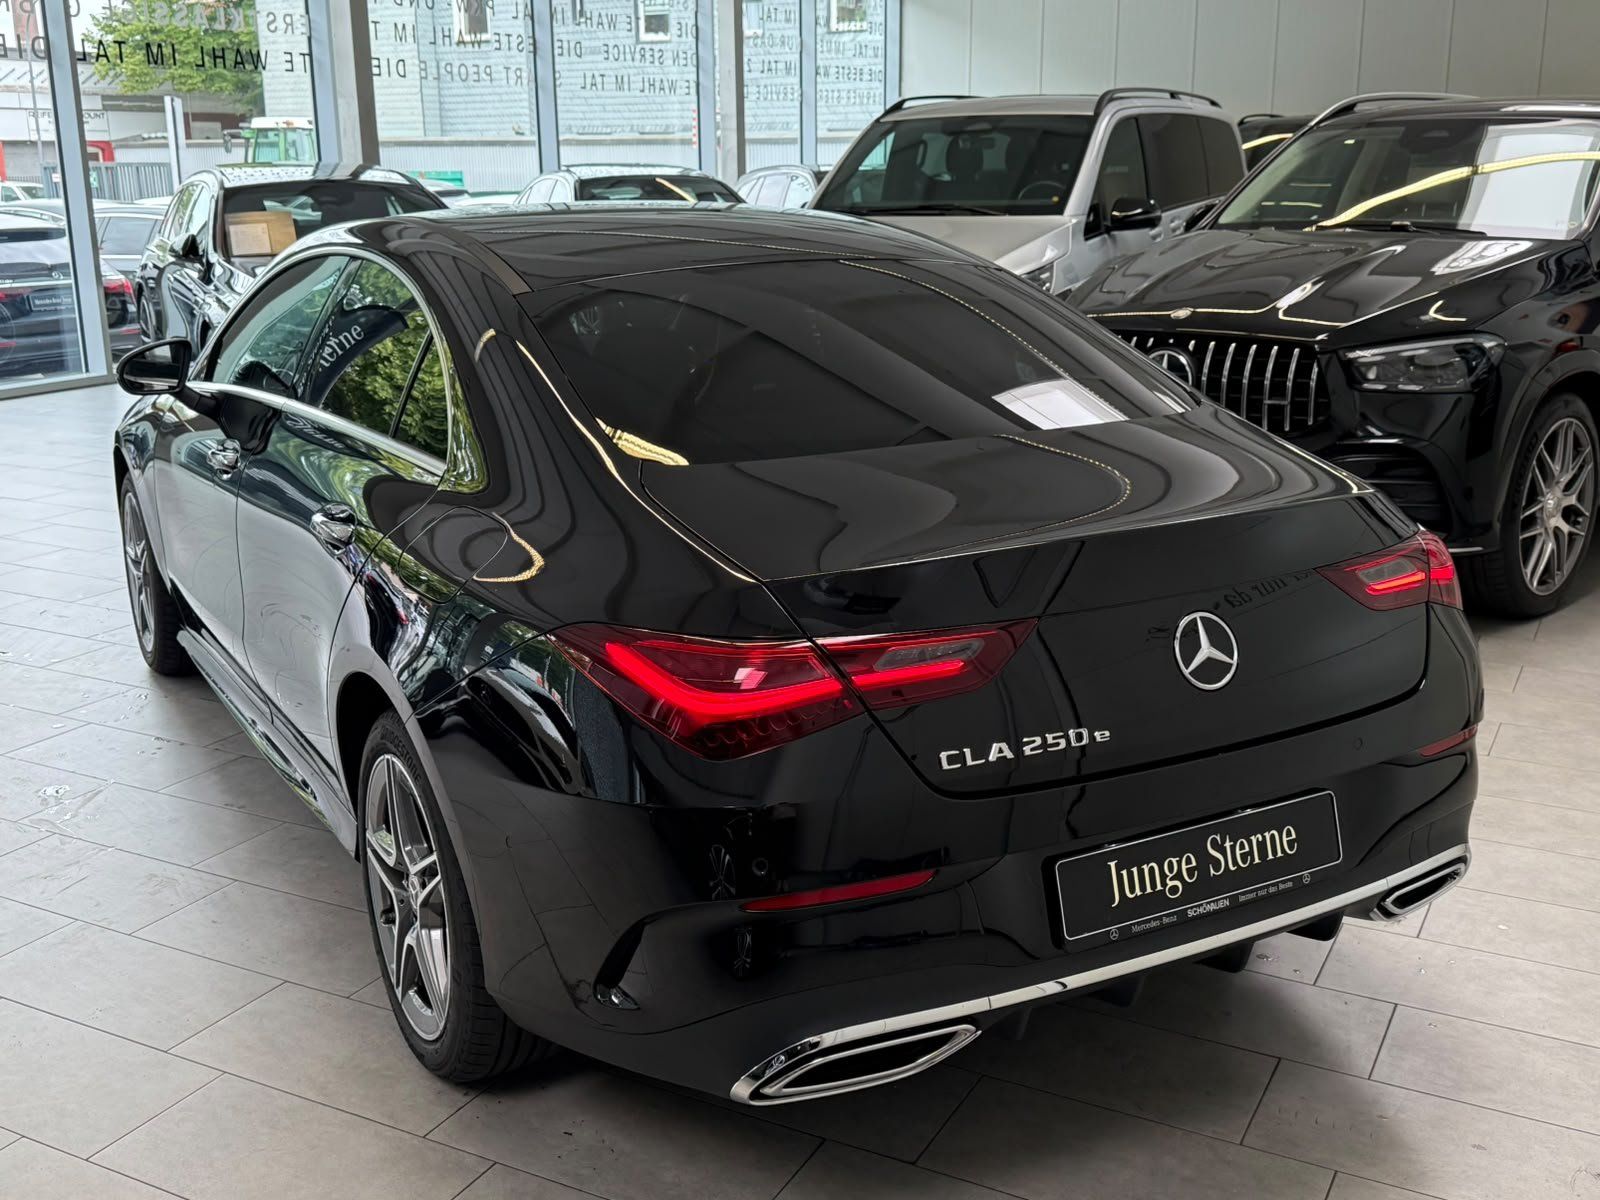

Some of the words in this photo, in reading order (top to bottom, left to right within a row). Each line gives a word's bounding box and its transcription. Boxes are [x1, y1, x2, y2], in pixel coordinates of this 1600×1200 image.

[939, 742, 1015, 770] CLA
[1107, 852, 1198, 907] Junge
[1207, 825, 1298, 877] Sterne
[1131, 914, 1178, 934] Mercedes-Benz
